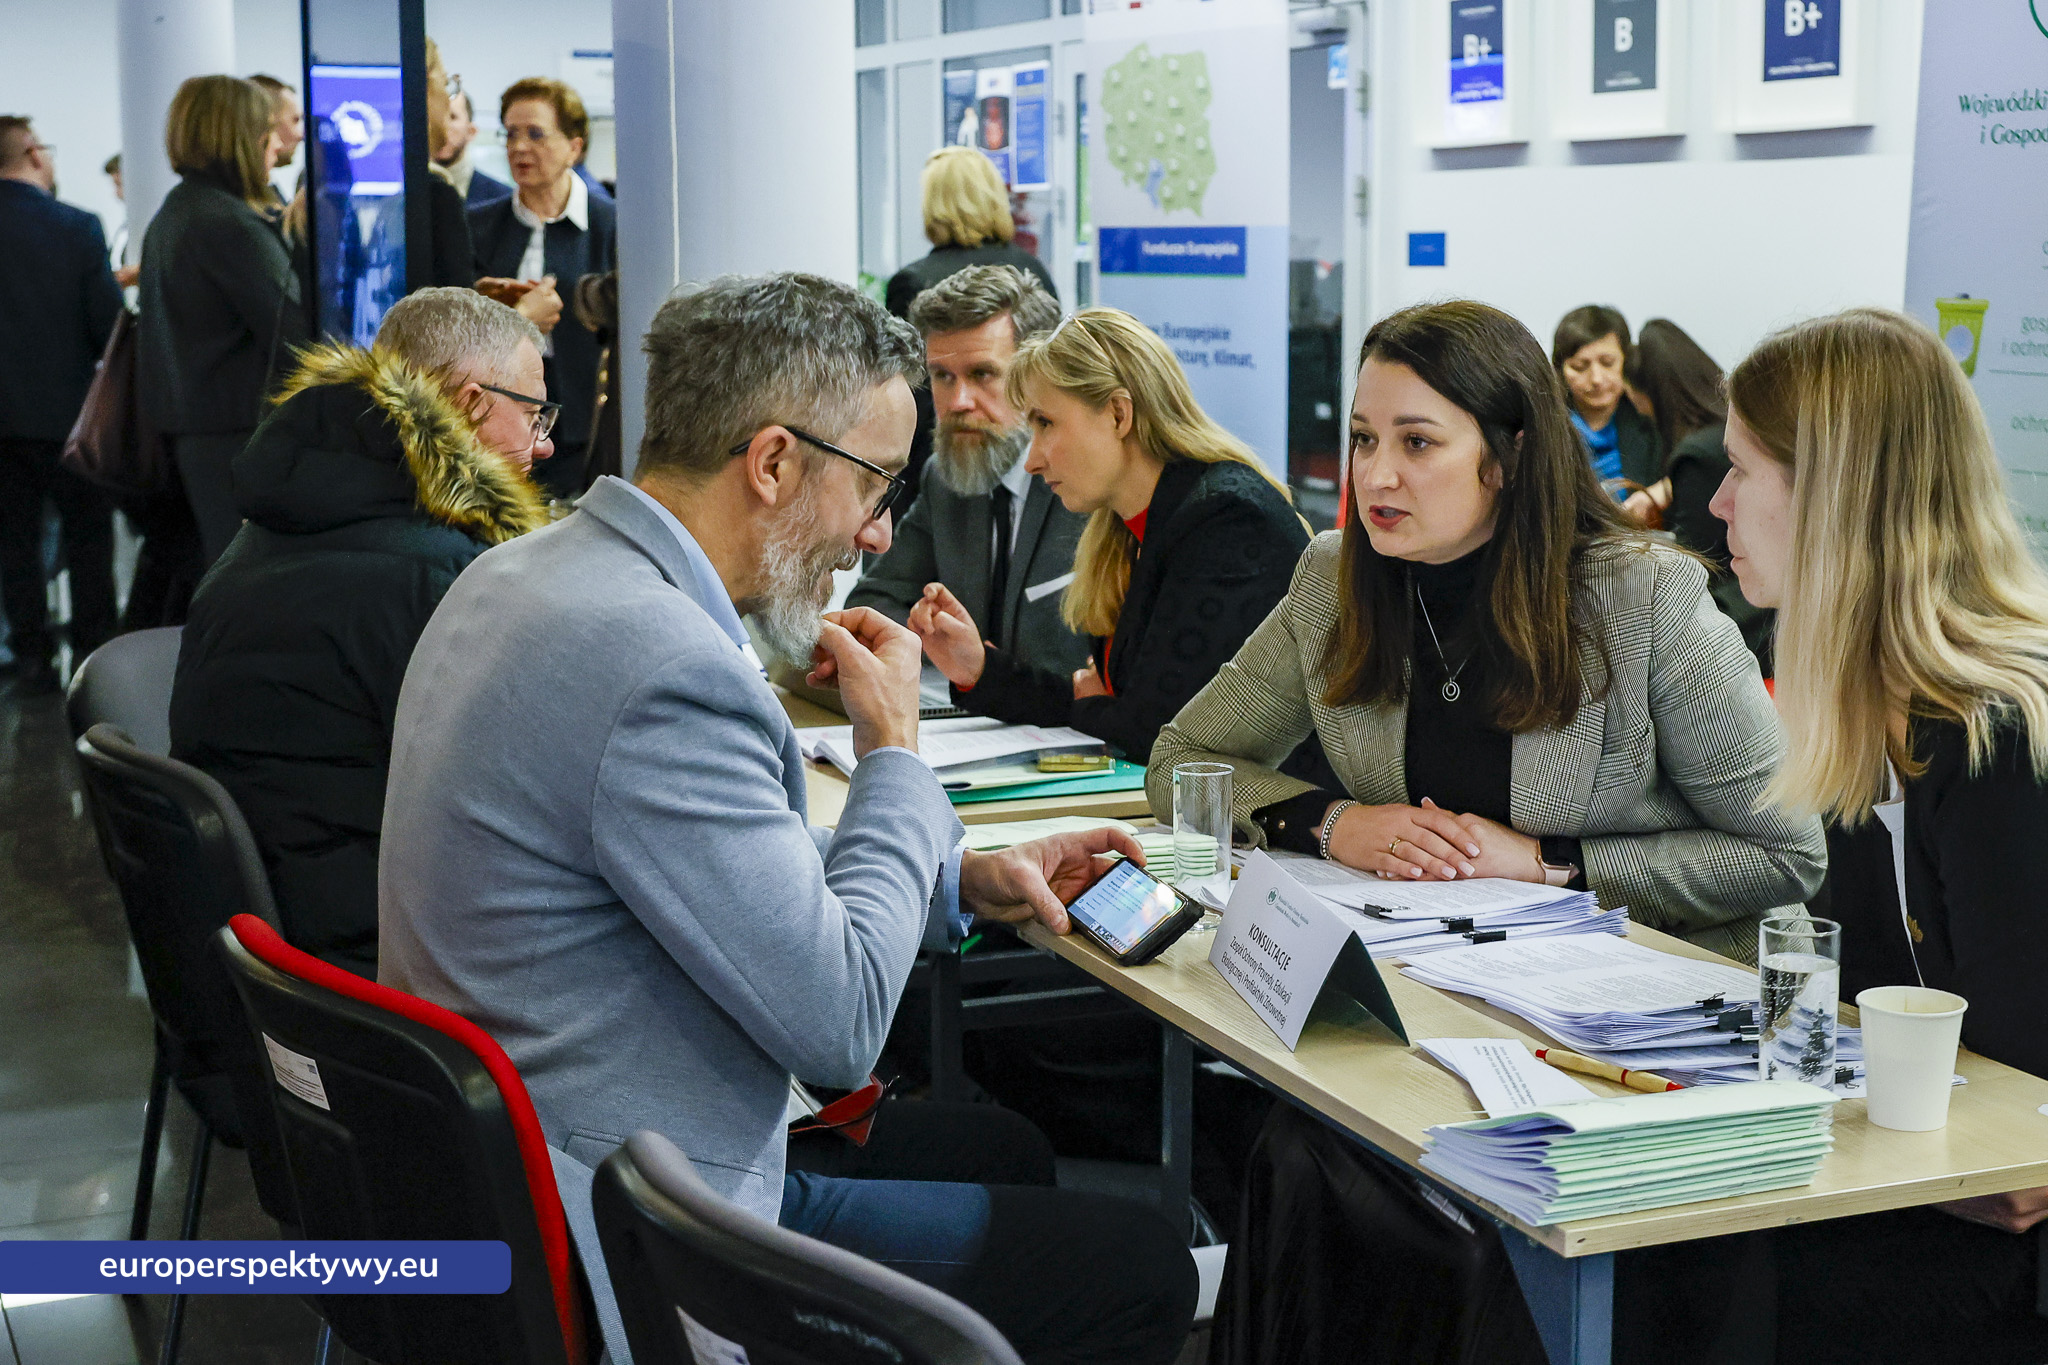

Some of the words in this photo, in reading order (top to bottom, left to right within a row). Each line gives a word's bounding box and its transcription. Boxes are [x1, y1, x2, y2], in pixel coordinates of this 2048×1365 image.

[1614, 17, 1633, 52] B
[1784, 0, 1823, 37] B+
[1463, 34, 1492, 66] B+
[1959, 88, 2048, 118] Wojewódzki
[1980, 124, 1986, 145] i
[1248, 923, 1291, 971] KONSULTACJE
[1221, 951, 1244, 983] Ekologicznej
[1244, 974, 1265, 1003] Profilaktyki
[1262, 994, 1287, 1029] Zdrowotnej
[1242, 947, 1258, 973] Ochrony
[1273, 979, 1292, 1006] Edukacji
